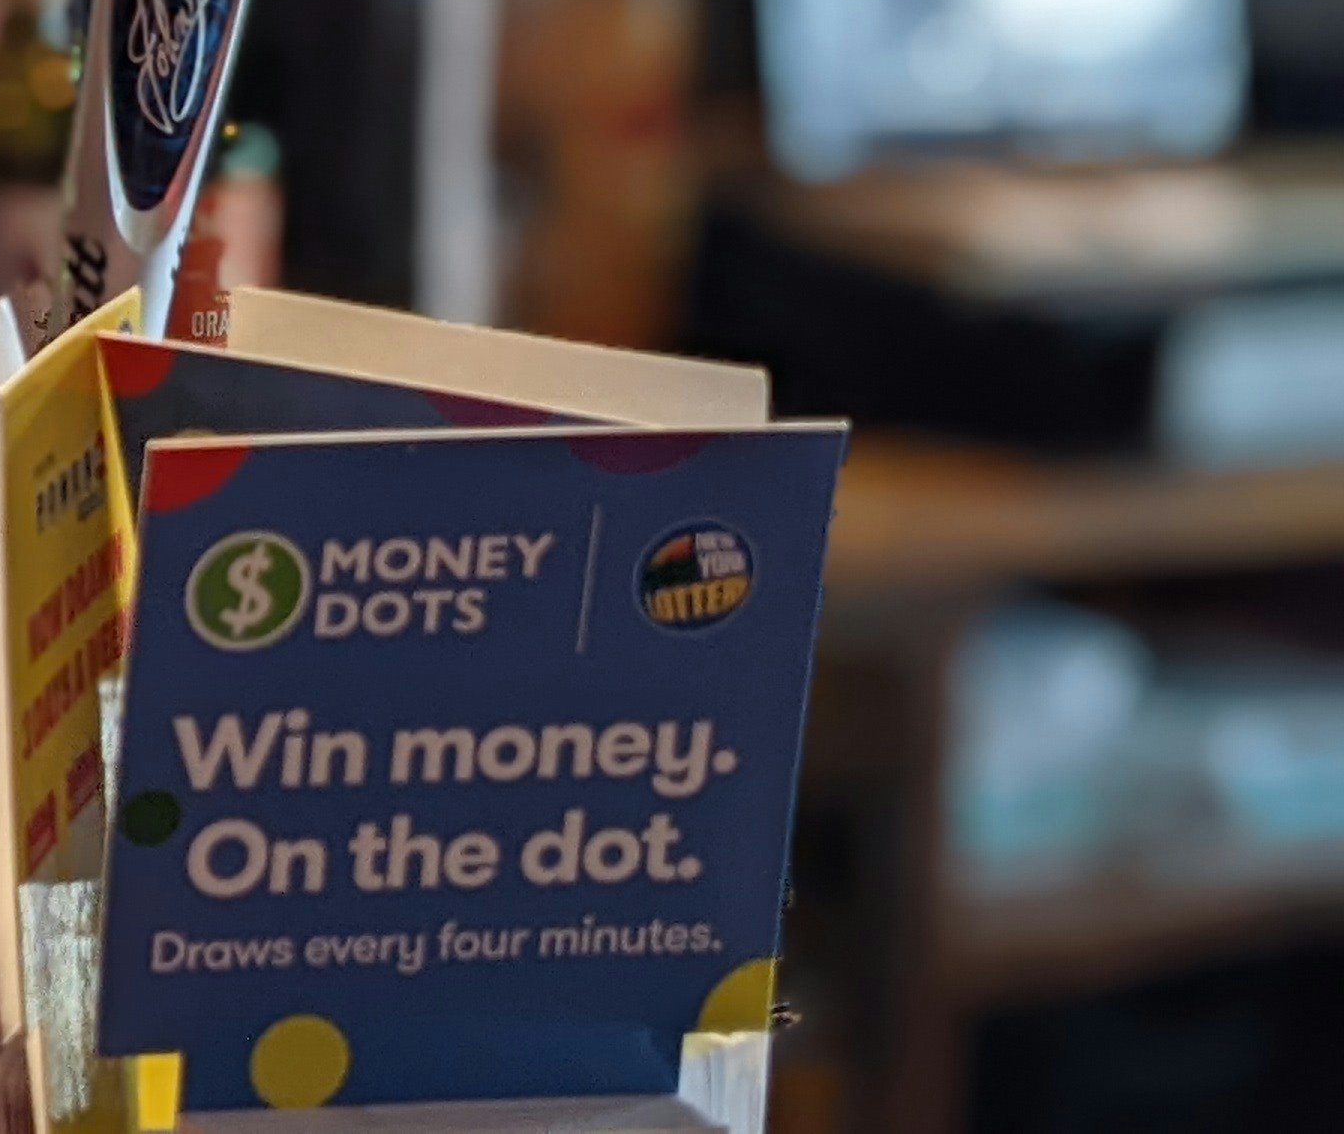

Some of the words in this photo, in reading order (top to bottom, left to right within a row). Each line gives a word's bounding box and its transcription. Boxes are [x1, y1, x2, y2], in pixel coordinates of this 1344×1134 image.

[319, 532, 554, 584] MONEY
[314, 588, 486, 638] DOTS
[171, 707, 367, 791] Win
[389, 718, 738, 798] money.
[186, 818, 326, 900] On
[348, 814, 501, 891] the
[520, 808, 702, 885] dot.
[150, 930, 293, 973] Draws
[304, 932, 424, 975] every
[437, 918, 531, 960] four
[538, 915, 724, 957] minutes.
